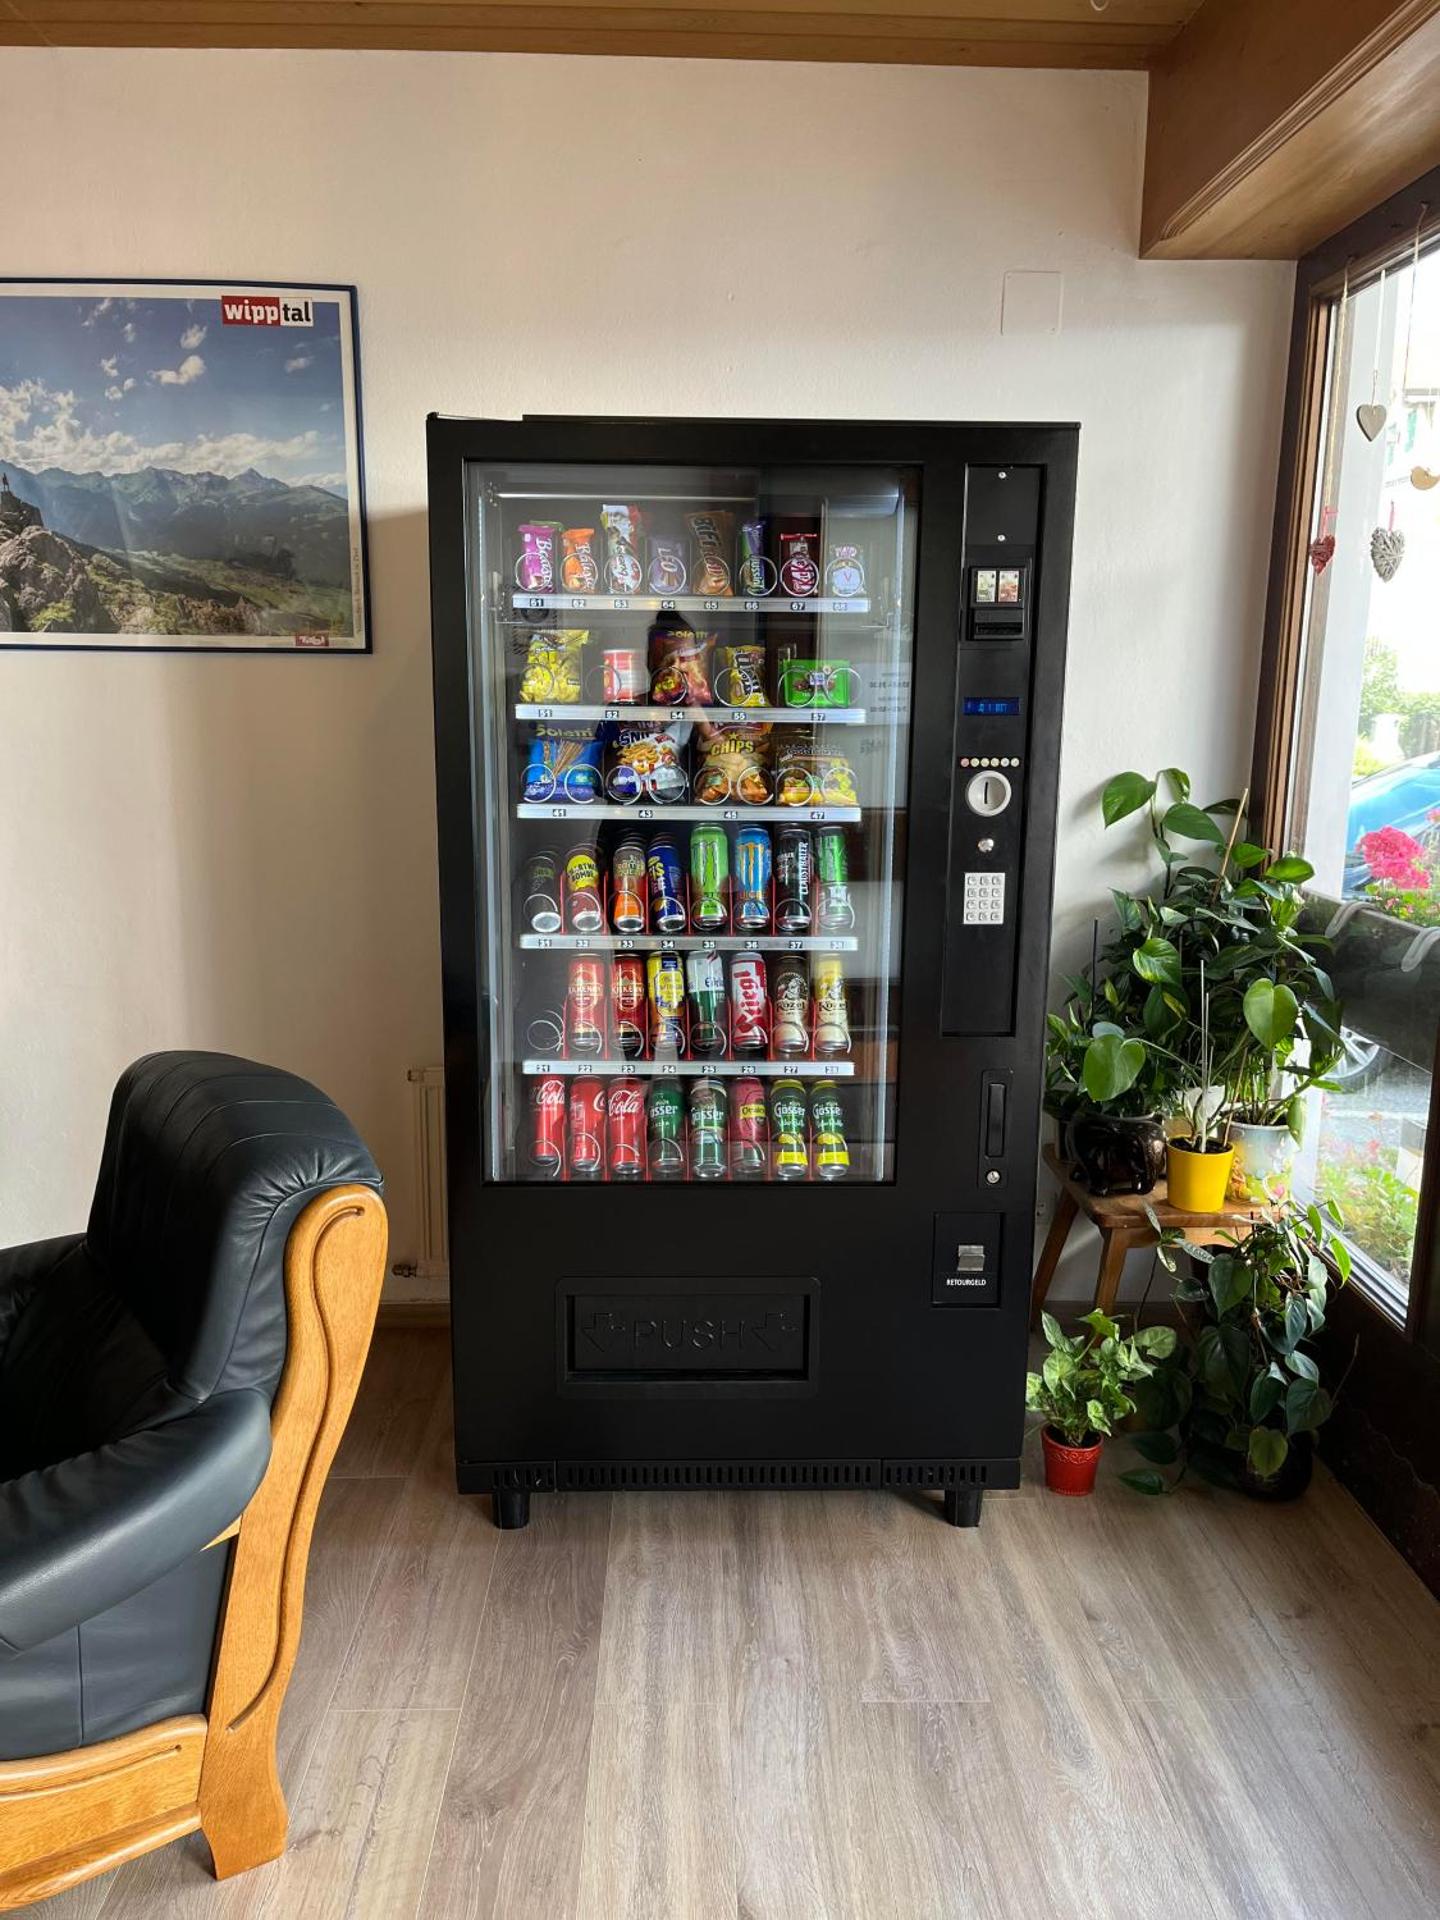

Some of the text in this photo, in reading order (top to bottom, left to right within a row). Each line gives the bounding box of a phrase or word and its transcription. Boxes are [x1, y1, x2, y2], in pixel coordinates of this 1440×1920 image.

[223, 299, 312, 325] wipptal
[573, 599, 585, 607] 62
[662, 601, 674, 609] 64
[705, 601, 718, 609] 65
[746, 602, 759, 610] 66
[792, 602, 805, 610] 67
[606, 710, 618, 718] 52
[671, 711, 684, 719] 54
[733, 712, 746, 720] 55
[639, 810, 653, 818] 43
[725, 811, 737, 819] 45
[811, 811, 825, 820] 47
[798, 841, 809, 896] CLAUSTHALER
[622, 940, 634, 948] 33
[662, 940, 674, 949] 34
[703, 941, 715, 949] 35
[745, 941, 758, 949] 36
[789, 941, 802, 949] 37
[734, 969, 765, 1037] Stiegl
[776, 1000, 806, 1013] Kozel
[579, 1065, 592, 1073] 22
[622, 1065, 635, 1073] 23
[663, 1065, 676, 1073] 24
[703, 1065, 716, 1073] 25
[784, 1066, 798, 1074] 27
[608, 1089, 640, 1117] Cola
[773, 1101, 806, 1118] Gösser
[946, 1278, 987, 1287] RETOURGELD
[633, 1318, 746, 1351] PUSH
